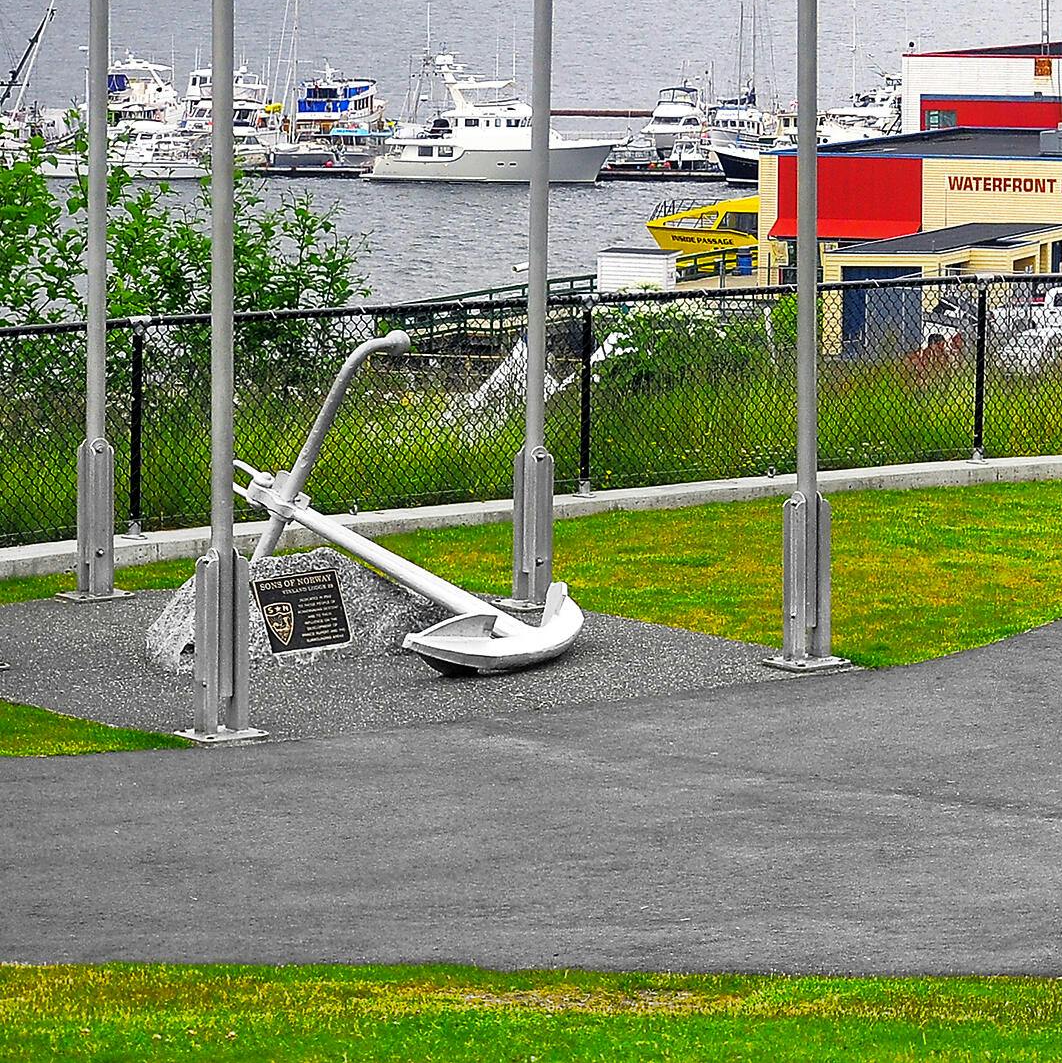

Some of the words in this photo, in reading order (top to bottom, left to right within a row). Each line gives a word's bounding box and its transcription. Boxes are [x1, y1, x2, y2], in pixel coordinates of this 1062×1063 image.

[947, 176, 1057, 194] WATERFRONT
[696, 237, 734, 246] PASSAGE
[259, 580, 283, 591] SONS
[284, 578, 296, 588] OF
[297, 574, 332, 586] NORWAY
